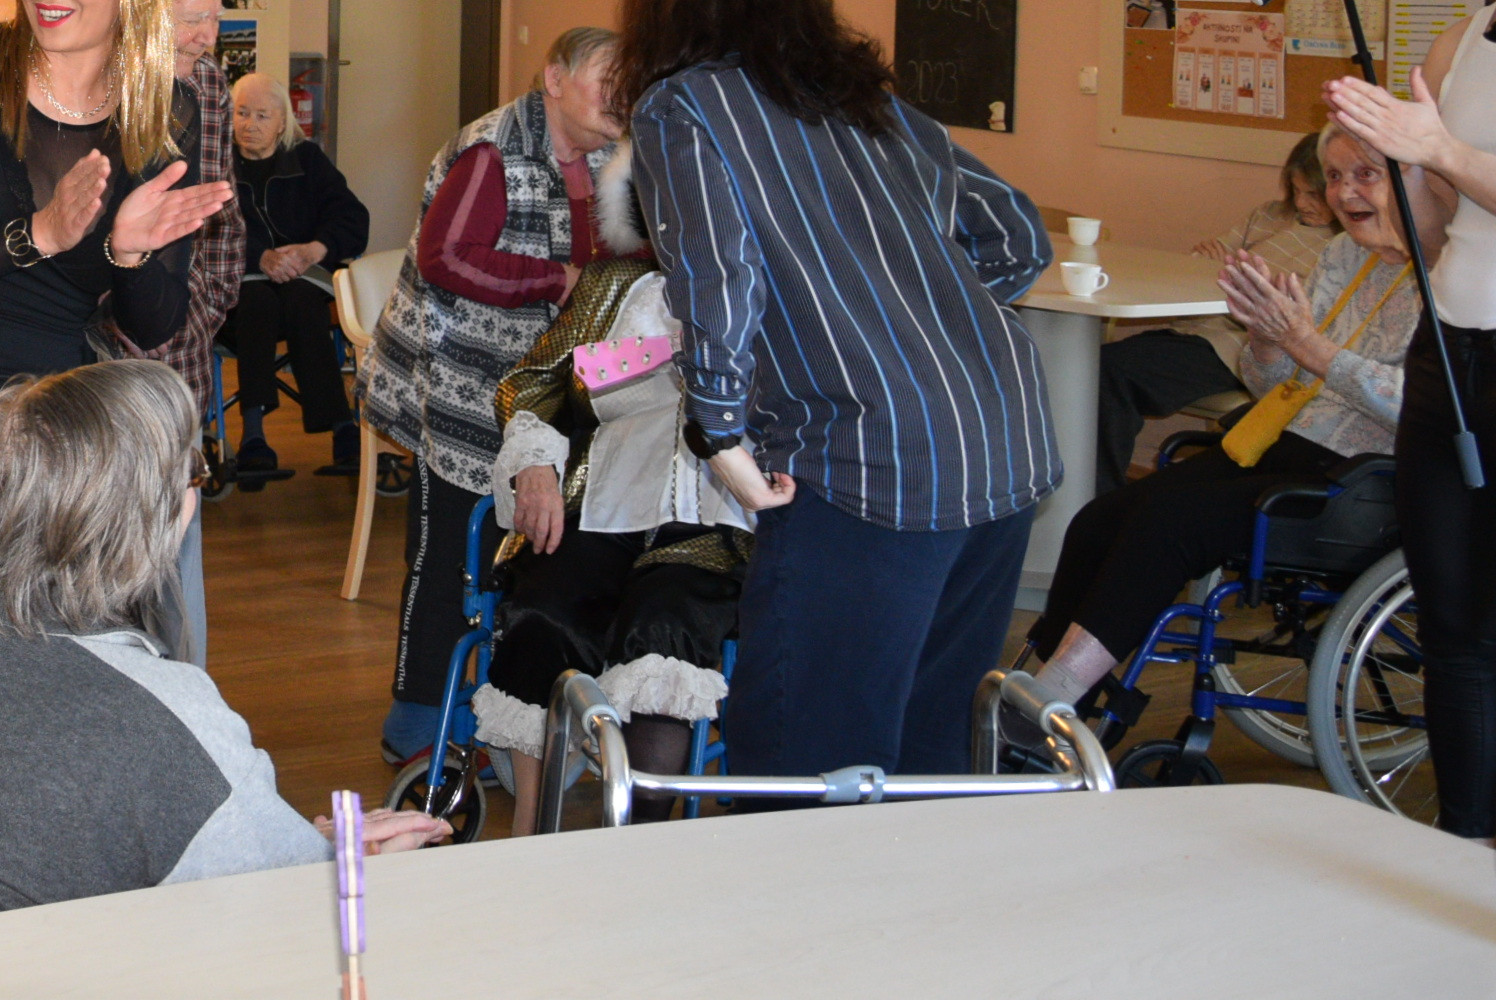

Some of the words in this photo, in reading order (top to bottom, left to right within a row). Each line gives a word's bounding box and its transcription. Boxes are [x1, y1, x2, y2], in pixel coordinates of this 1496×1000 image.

[906, 60, 959, 104] 2023
[417, 456, 429, 510] ESSENTIALS
[413, 515, 428, 571] TESSENTIALS
[403, 575, 420, 631] TESSENTIALS
